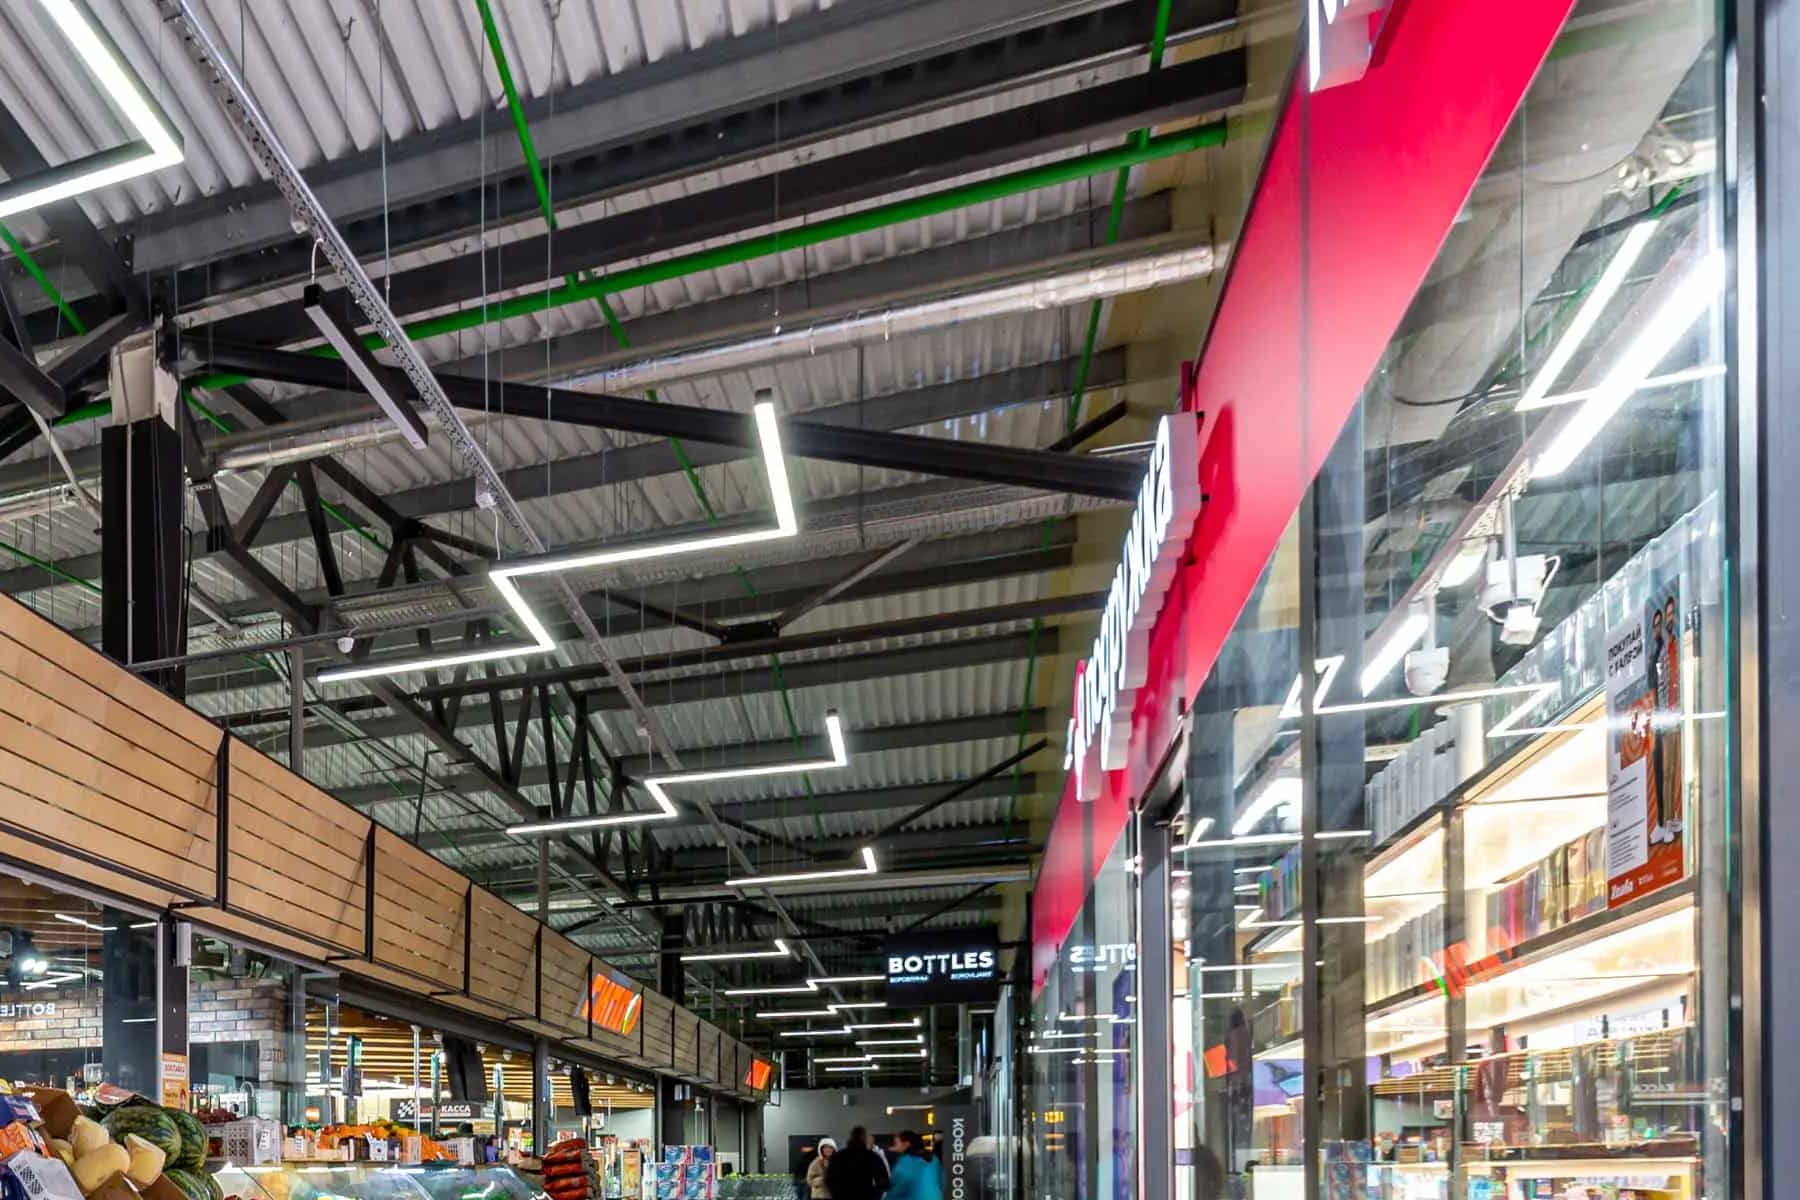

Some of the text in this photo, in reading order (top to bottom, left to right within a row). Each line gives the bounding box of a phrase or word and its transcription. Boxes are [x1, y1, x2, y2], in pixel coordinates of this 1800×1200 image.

[888, 951, 994, 974] BOTTLES
[952, 1118, 964, 1161] КОФЕ
[952, 1164, 964, 1175] С
